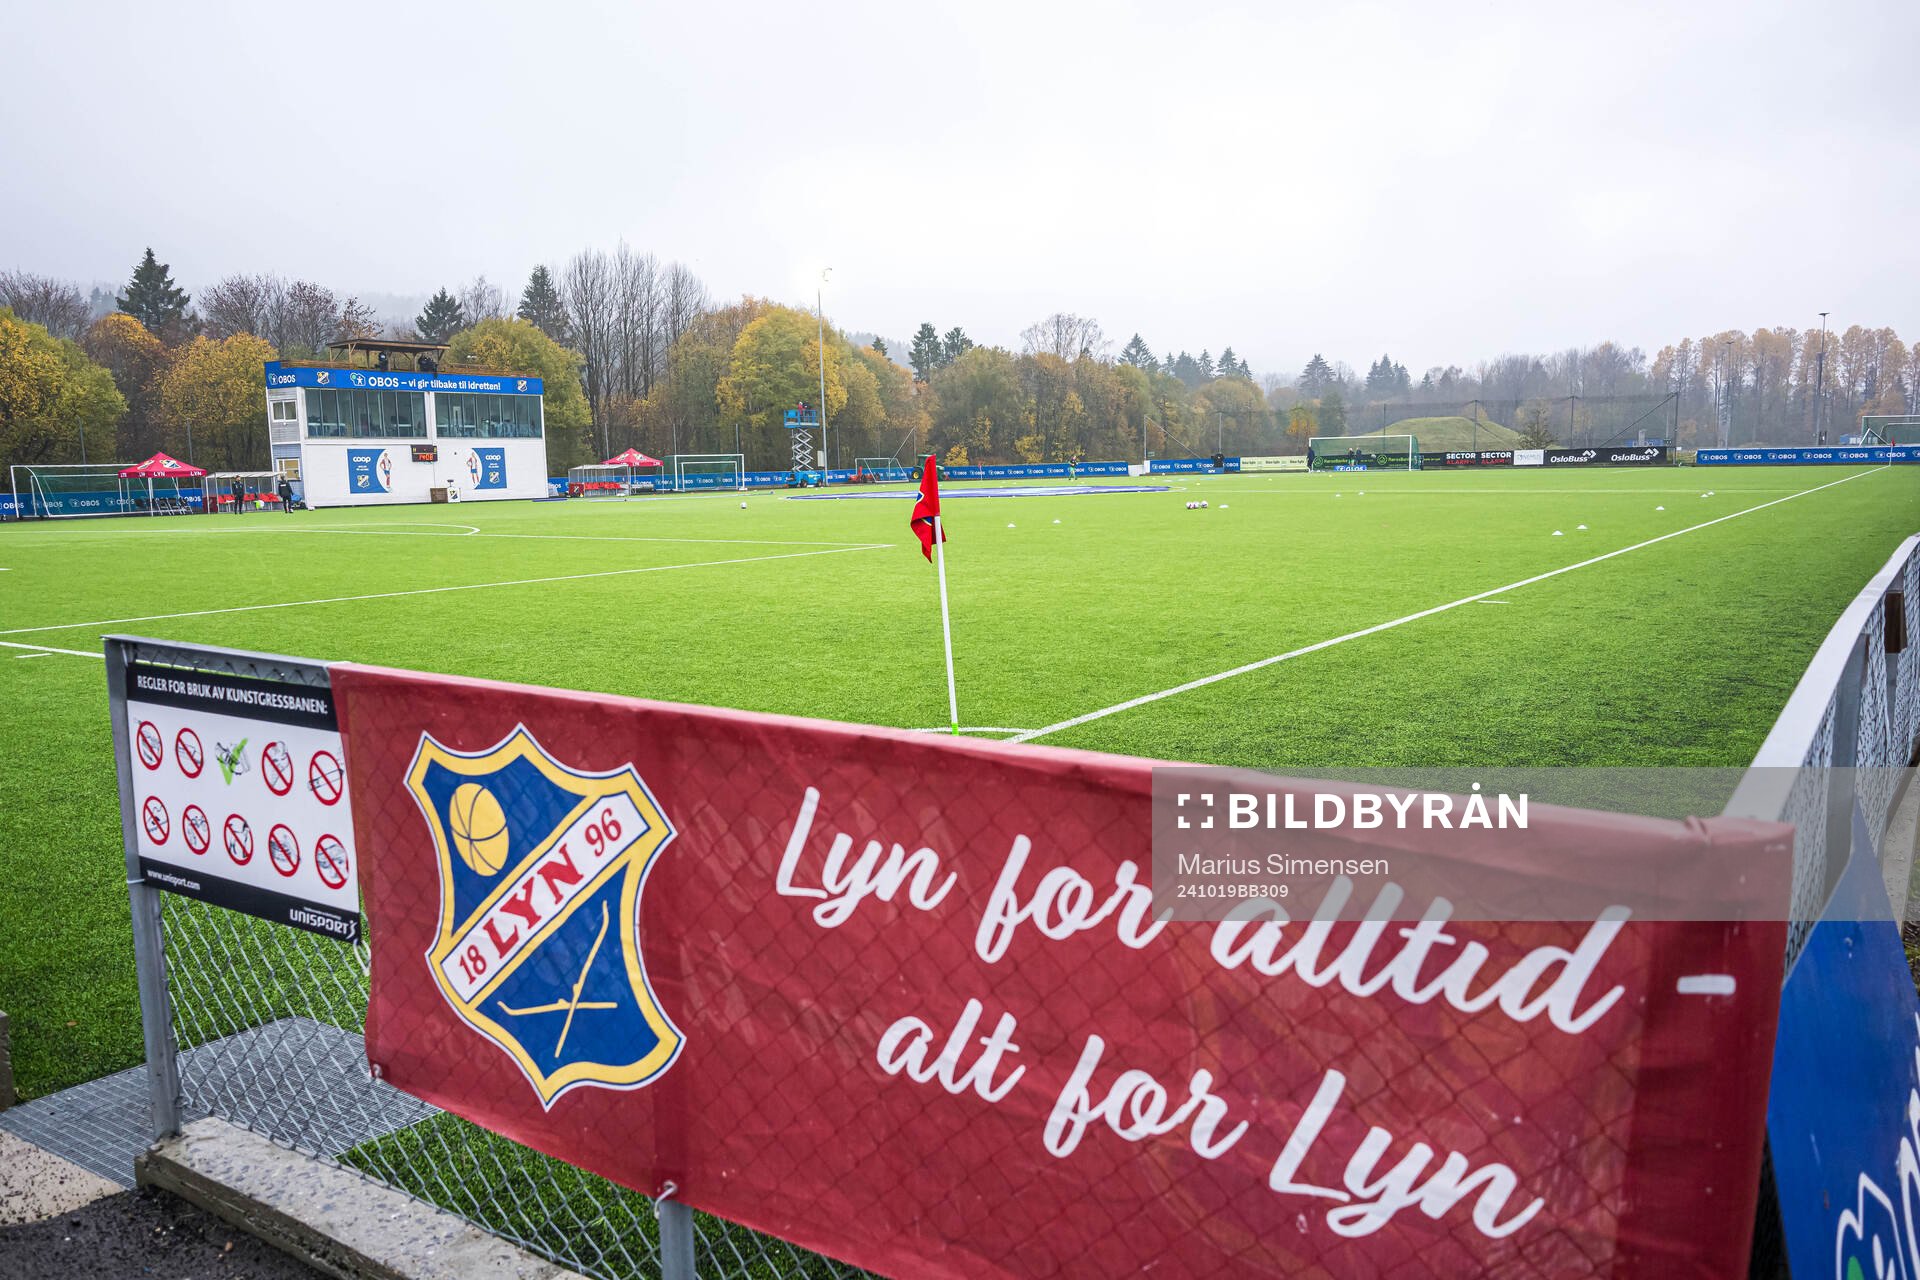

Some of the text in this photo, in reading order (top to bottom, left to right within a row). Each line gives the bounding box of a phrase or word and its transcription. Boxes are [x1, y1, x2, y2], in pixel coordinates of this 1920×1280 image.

[278, 374, 296, 384] OBOS
[368, 376, 399, 387] OBOS
[408, 379, 416, 388] vi
[417, 379, 429, 390] gir
[430, 380, 457, 389] tilbake
[458, 381, 467, 389] til
[468, 381, 501, 391] idretten!
[1550, 455, 1588, 463] OsloBuss
[1611, 453, 1650, 462] OsloBuss
[137, 675, 329, 714] REGLER FOR BRUK AV KUNSTGRESSBANEN:
[146, 869, 201, 891] www.unisport.com
[775, 786, 958, 929] Lyn
[974, 833, 1175, 964] for
[458, 807, 623, 985] 18 LYN 96
[876, 998, 1546, 1239] alt for Lyn
